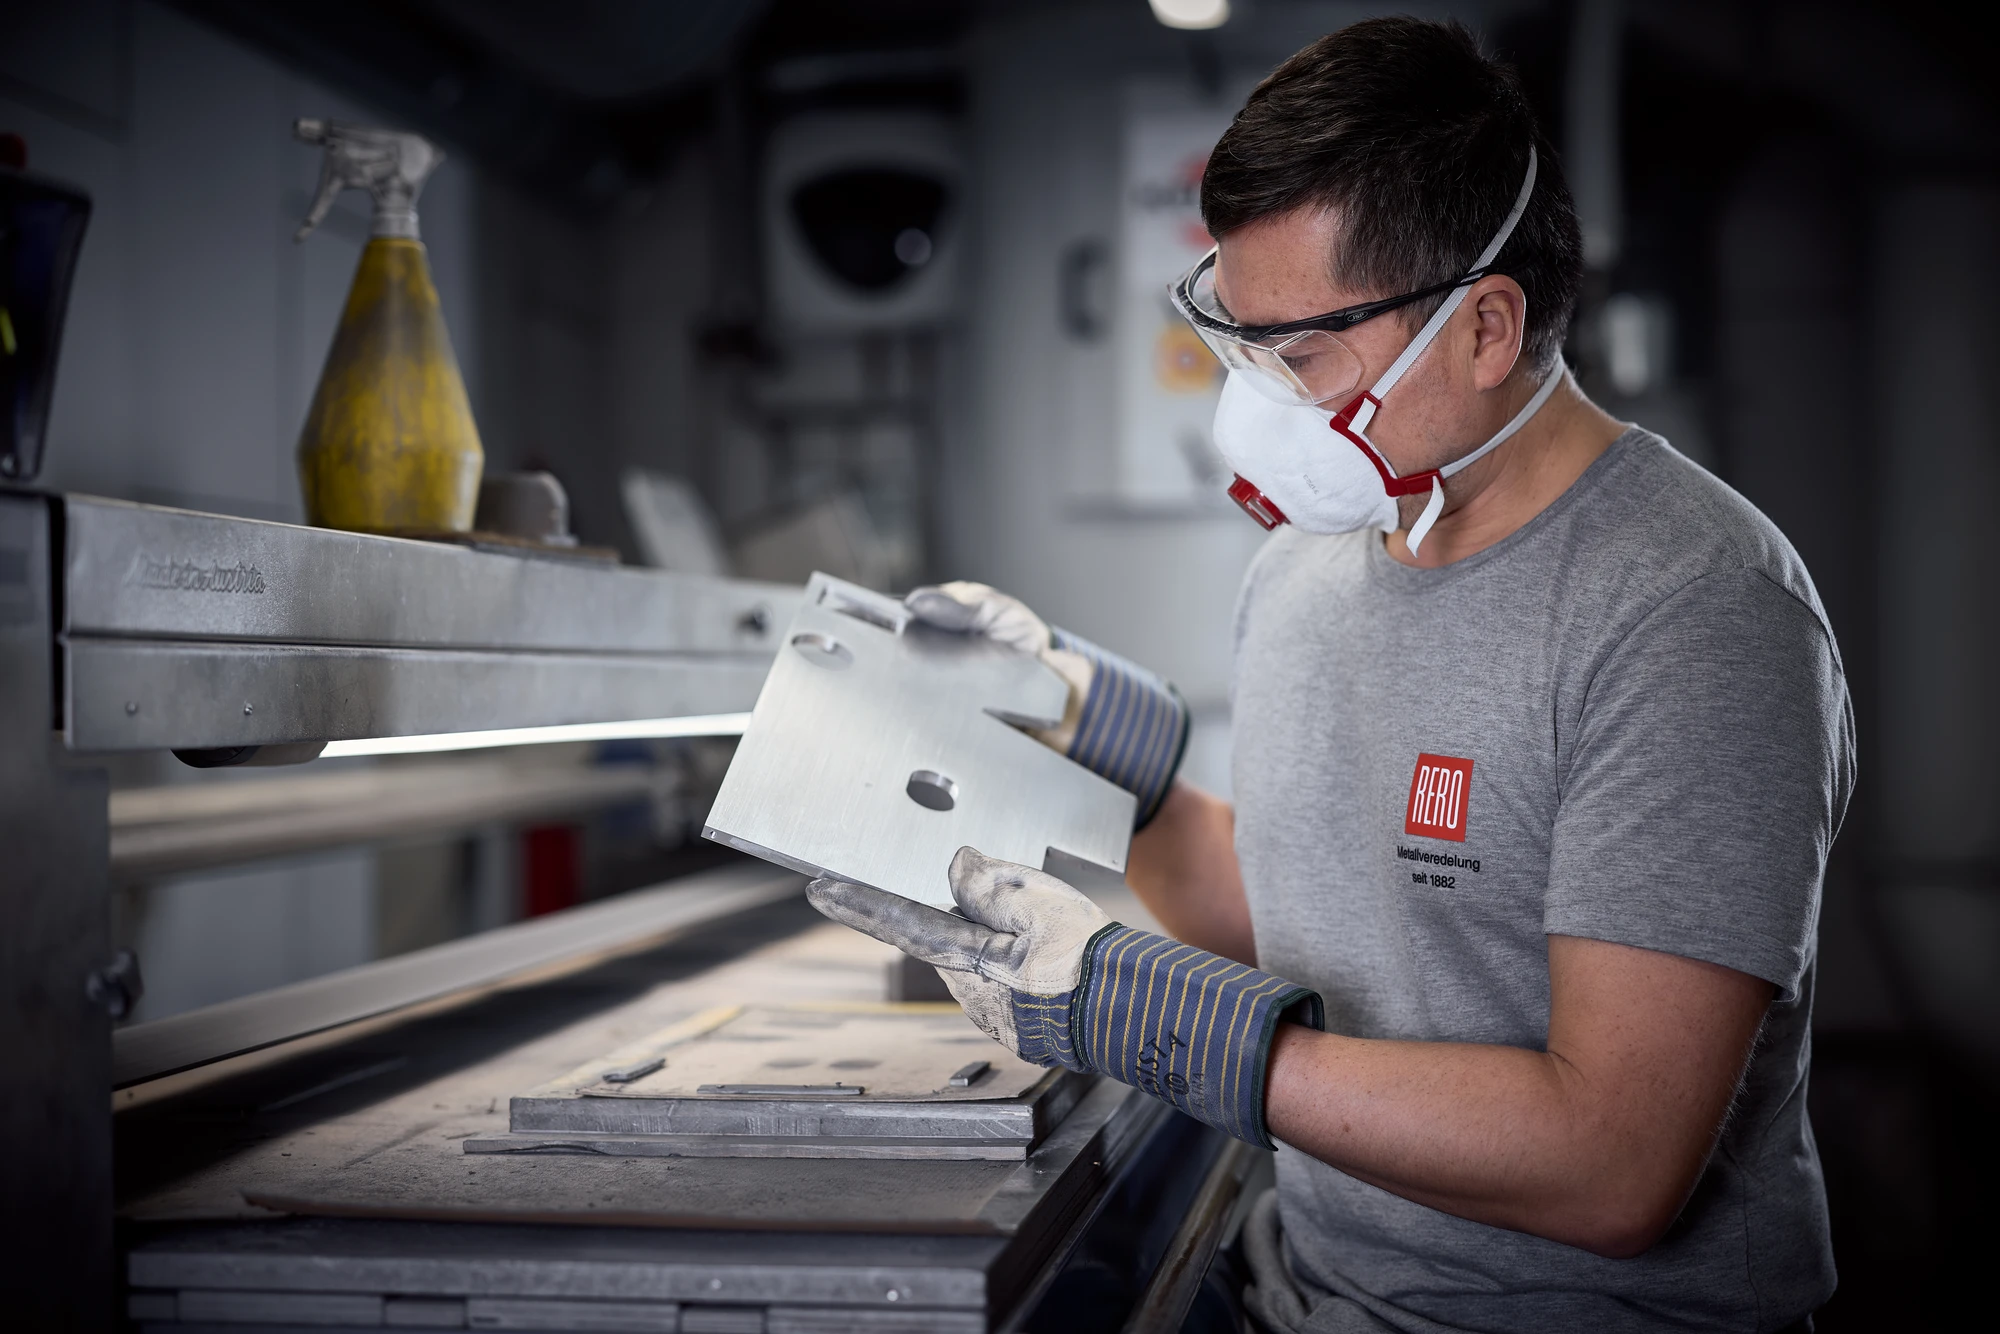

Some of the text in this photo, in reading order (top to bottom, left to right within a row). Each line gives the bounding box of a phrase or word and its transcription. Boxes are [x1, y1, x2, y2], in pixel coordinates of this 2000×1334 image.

[202, 557, 266, 594] Austria
[1411, 765, 1463, 829] RERO
[1397, 845, 1480, 872] Metallveredelung
[1411, 872, 1456, 889] seit 1882
